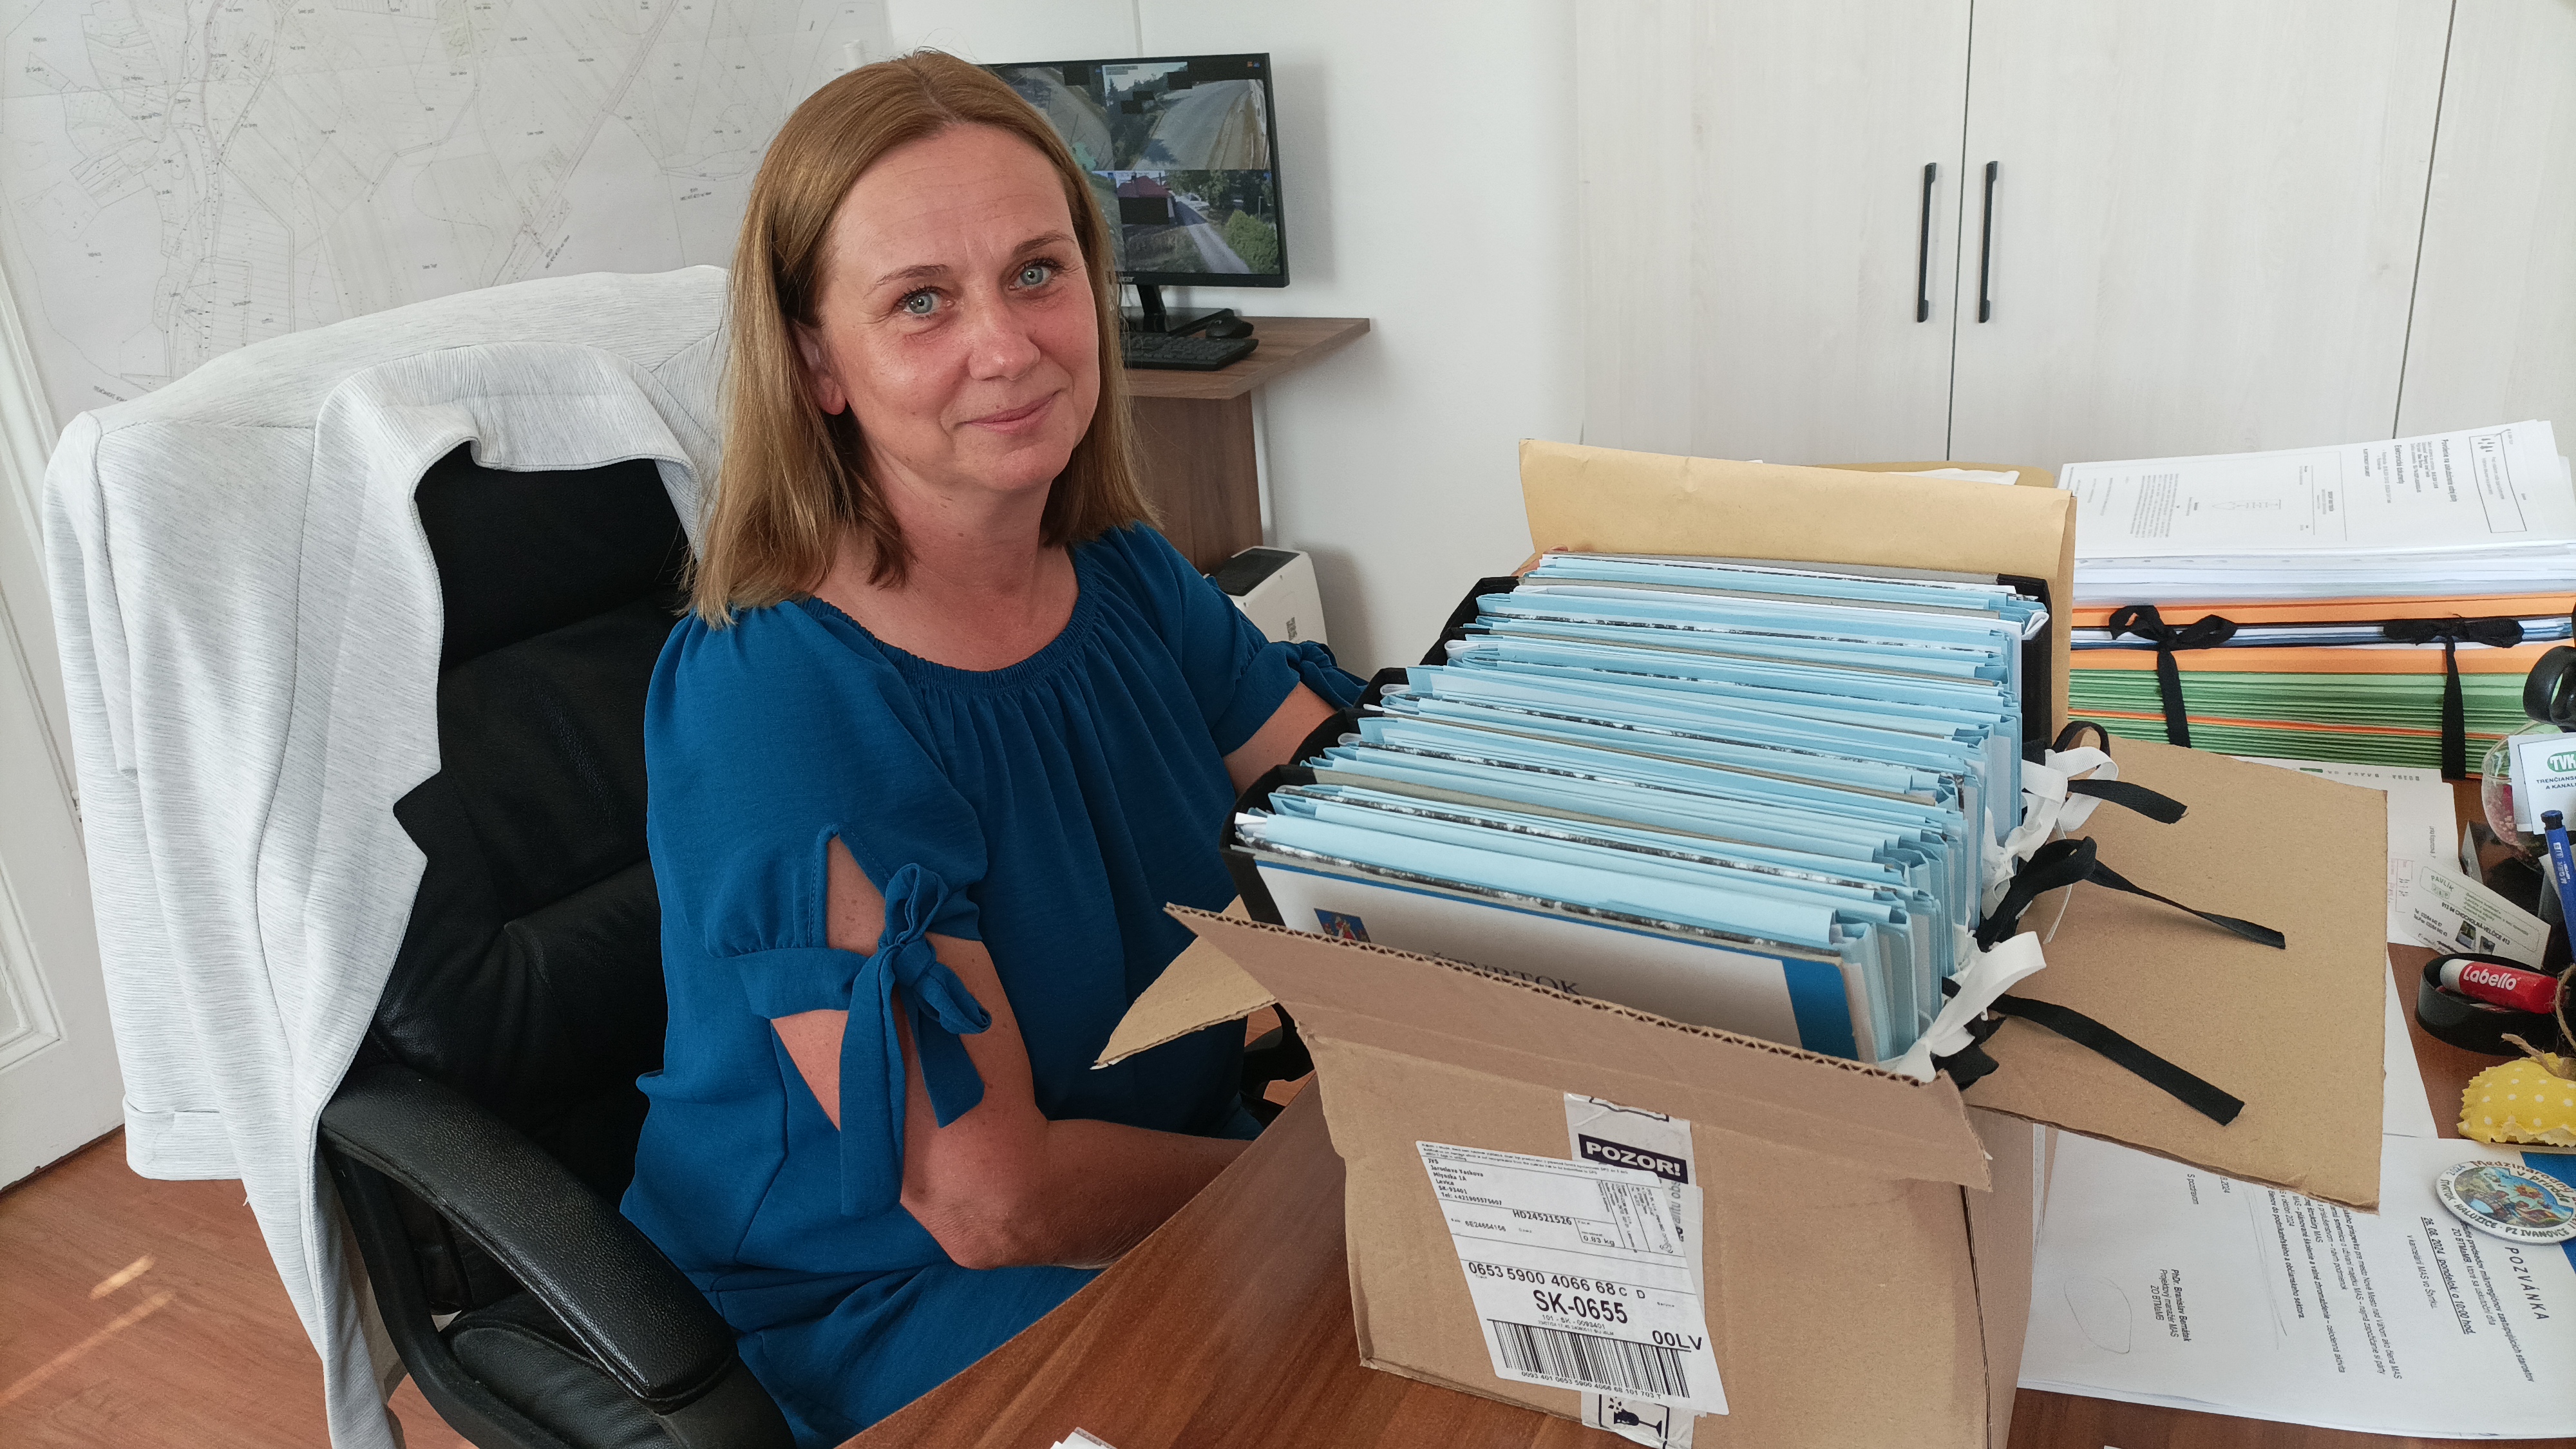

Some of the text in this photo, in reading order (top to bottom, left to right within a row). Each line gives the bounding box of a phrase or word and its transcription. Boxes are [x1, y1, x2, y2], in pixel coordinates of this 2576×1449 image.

[2463, 965, 2517, 990] Labello
[1586, 1141, 1681, 1177] POZOR!
[2293, 1196, 2302, 1206] MAS
[1513, 1209, 1573, 1226] HD24521526
[2286, 1215, 2295, 1226] 2024
[2454, 1202, 2498, 1229] HALUZICE
[2505, 1226, 2518, 1235] PZ
[2521, 1227, 2570, 1238] IVANOVCE
[2314, 1231, 2323, 1242] MAS
[2432, 1240, 2445, 1254] 2024
[2358, 1261, 2367, 1276] mesto
[2418, 1266, 2429, 1279] MAS
[1468, 1262, 1646, 1299] 0653 5900 4066 68 C D
[2172, 1269, 2180, 1285] PhDr.
[2505, 1246, 2550, 1320] POZVÁNKA
[2150, 1285, 2159, 1294] ZO
[2364, 1278, 2372, 1293] Nové
[2174, 1287, 2185, 1316] Branislav
[2354, 1288, 2363, 1300] MAS
[2368, 1292, 2377, 1307] Mesto
[1533, 1289, 1629, 1324] SK-0655
[2159, 1269, 2172, 1300] Projektový
[2169, 1323, 2179, 1337] MAS
[2468, 1240, 2484, 1271] predsedov
[2516, 1354, 2534, 1381] starostov
[2372, 1309, 2382, 1318] nad
[2455, 1302, 2469, 1321] 10:00
[2376, 1320, 2387, 1337] Váhom
[2460, 1318, 2476, 1334] hod.
[1652, 1330, 1702, 1350] 00LV
[2385, 1350, 2395, 1364] člena
[1521, 1370, 1539, 1379] 0093
[1575, 1379, 1593, 1388] 5900
[2391, 1366, 2402, 1379] MAS
